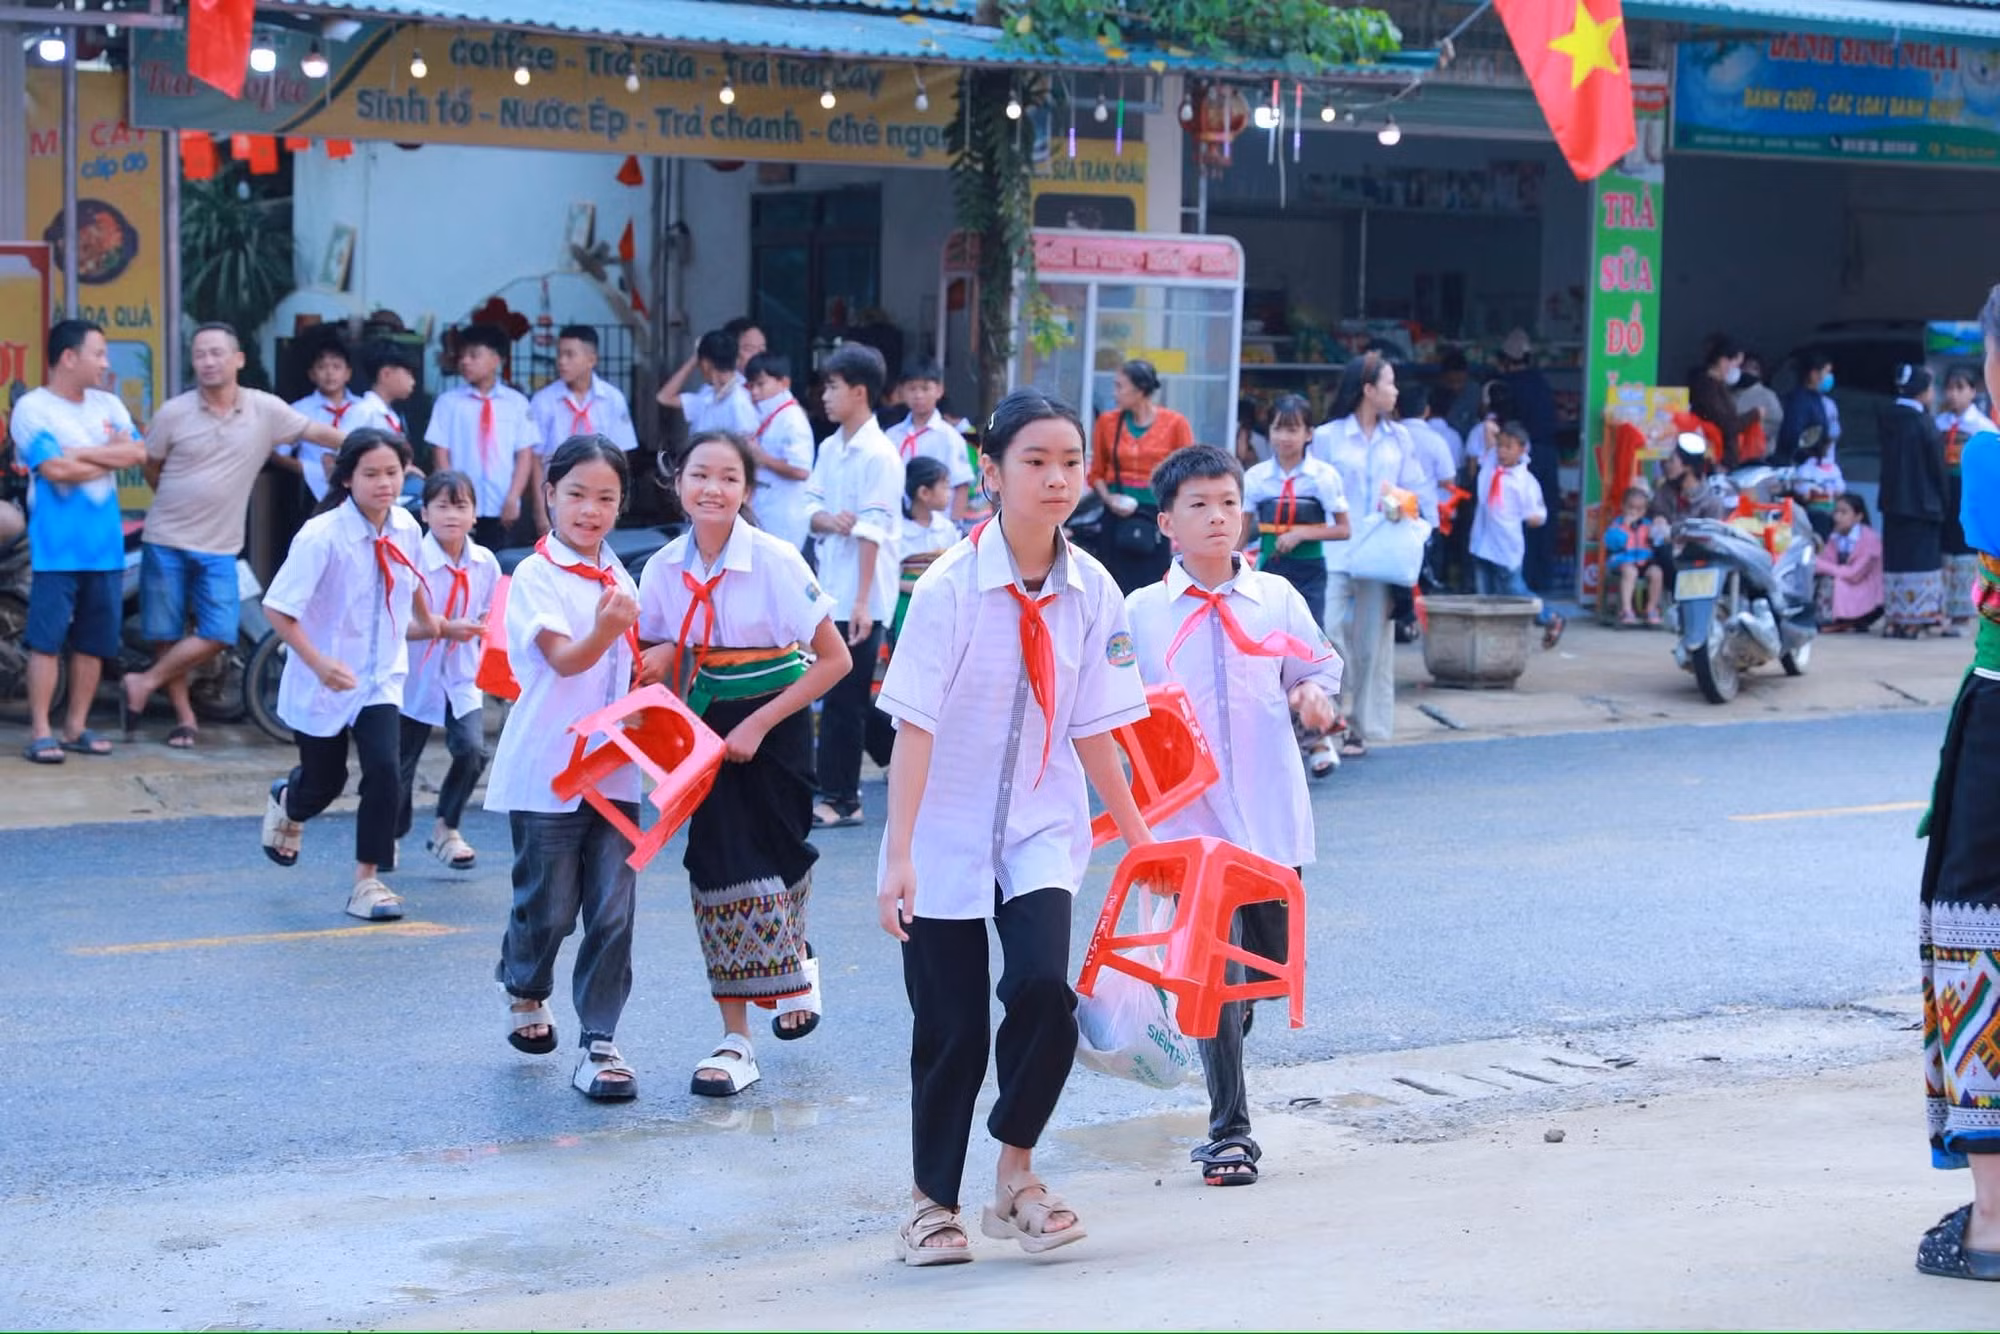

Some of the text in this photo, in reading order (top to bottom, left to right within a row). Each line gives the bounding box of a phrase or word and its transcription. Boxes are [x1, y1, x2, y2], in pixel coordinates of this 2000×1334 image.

[356, 85, 429, 124] Sinh
[434, 86, 473, 128] tố
[500, 96, 581, 133] Nước
[1604, 184, 1657, 230] TRÀ
[1600, 246, 1655, 293] SỮA
